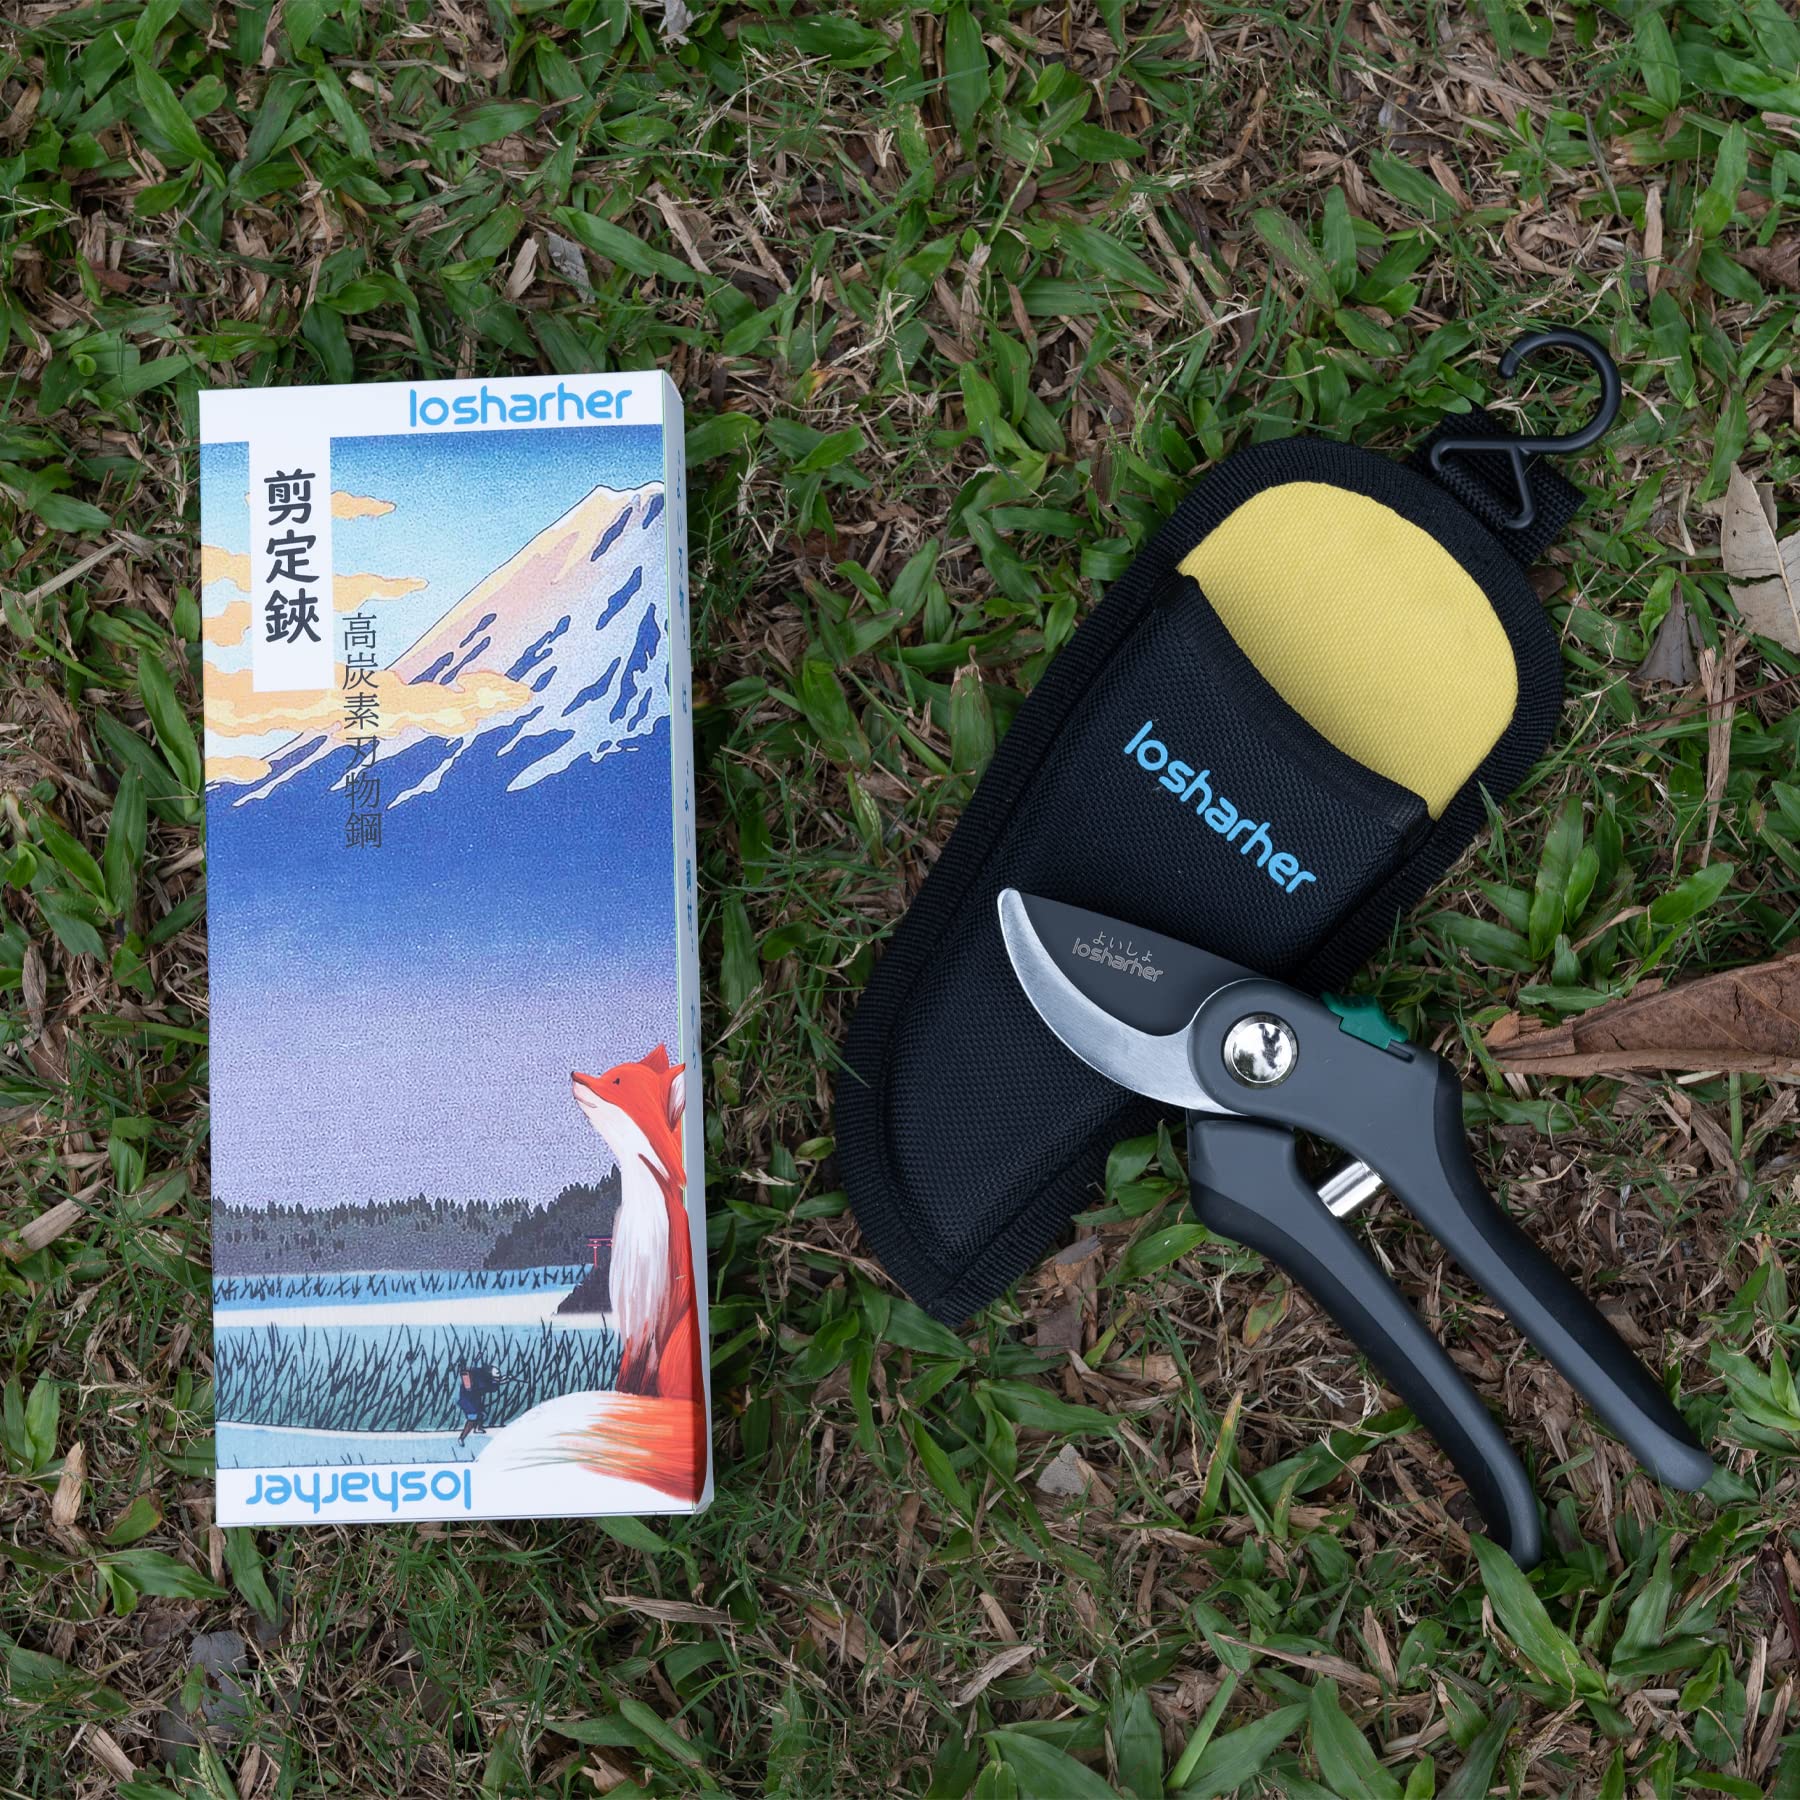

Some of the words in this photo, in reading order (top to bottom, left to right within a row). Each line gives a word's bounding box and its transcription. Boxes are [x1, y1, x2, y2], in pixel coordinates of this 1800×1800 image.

[409, 383, 632, 427] losharher
[264, 469, 322, 644] 剪定鋏
[342, 612, 382, 849] 高炭素刃物鋼
[1123, 720, 1317, 893] losharher
[1072, 937, 1163, 982] losharher
[1093, 931, 1152, 962] よいしょ
[246, 1469, 472, 1513] losharher
